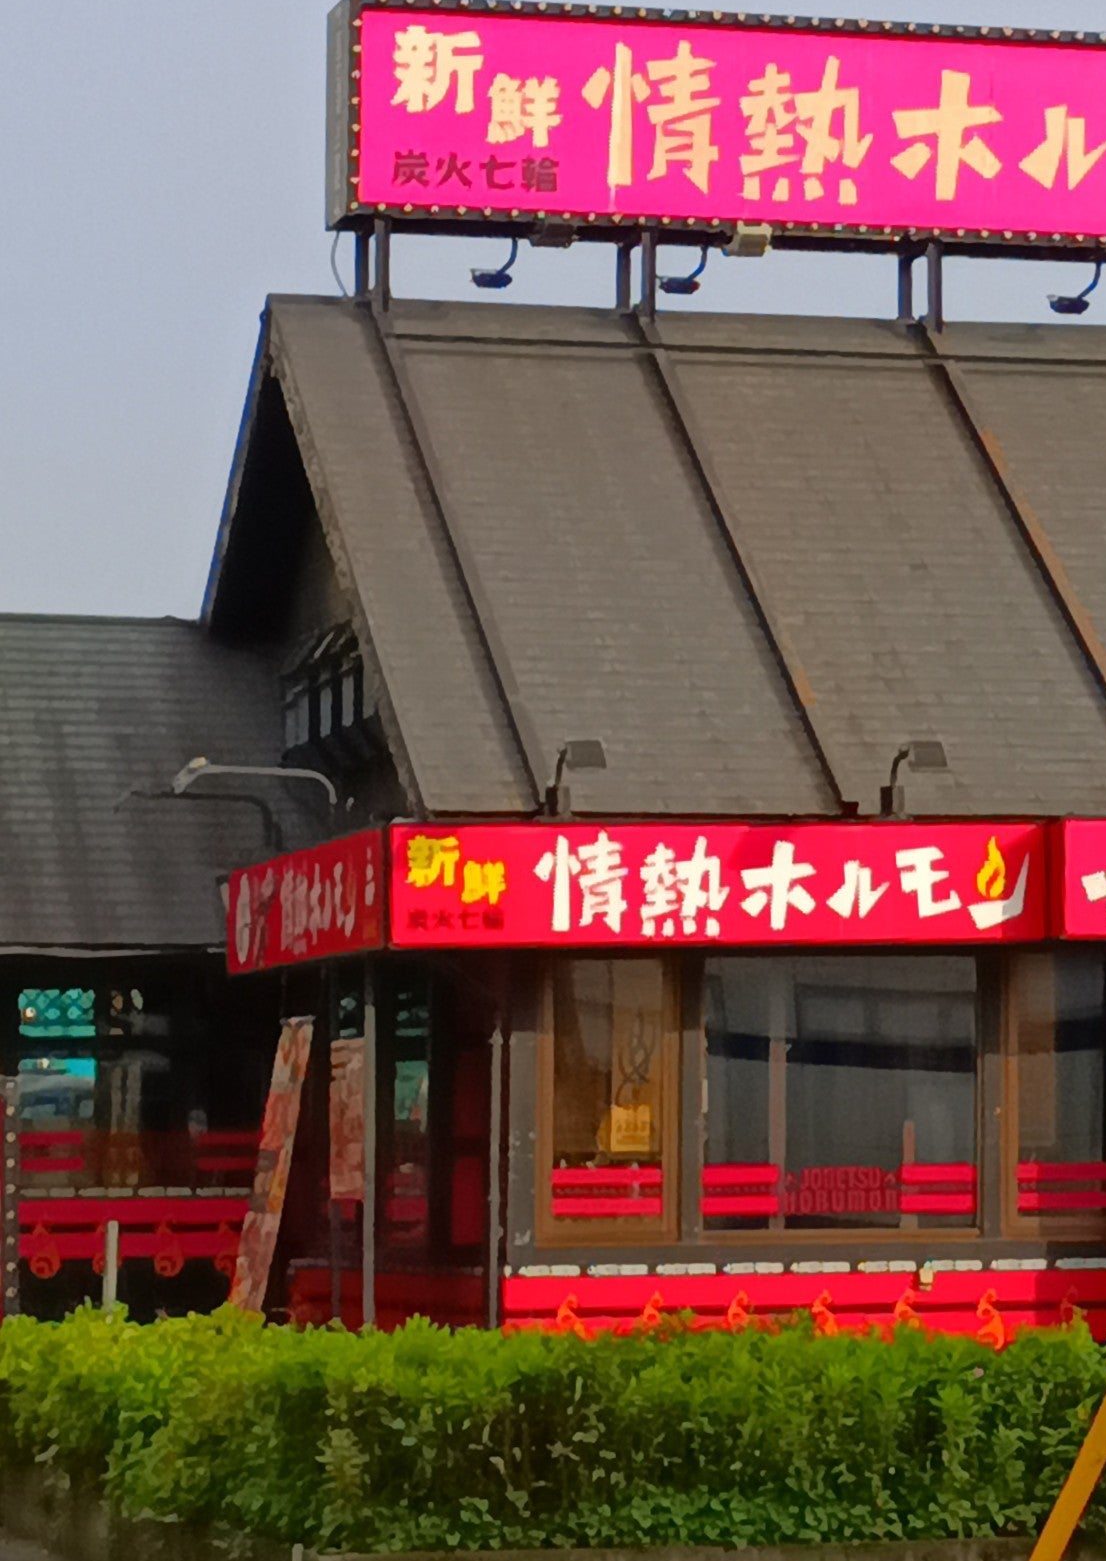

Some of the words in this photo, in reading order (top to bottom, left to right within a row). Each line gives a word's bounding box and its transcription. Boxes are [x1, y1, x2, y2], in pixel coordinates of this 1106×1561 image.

[391, 25, 561, 147] 新鮮
[392, 148, 559, 192] 炭火七輪
[405, 835, 506, 904] 新鮮
[534, 831, 1030, 938] 情熱ホルモン
